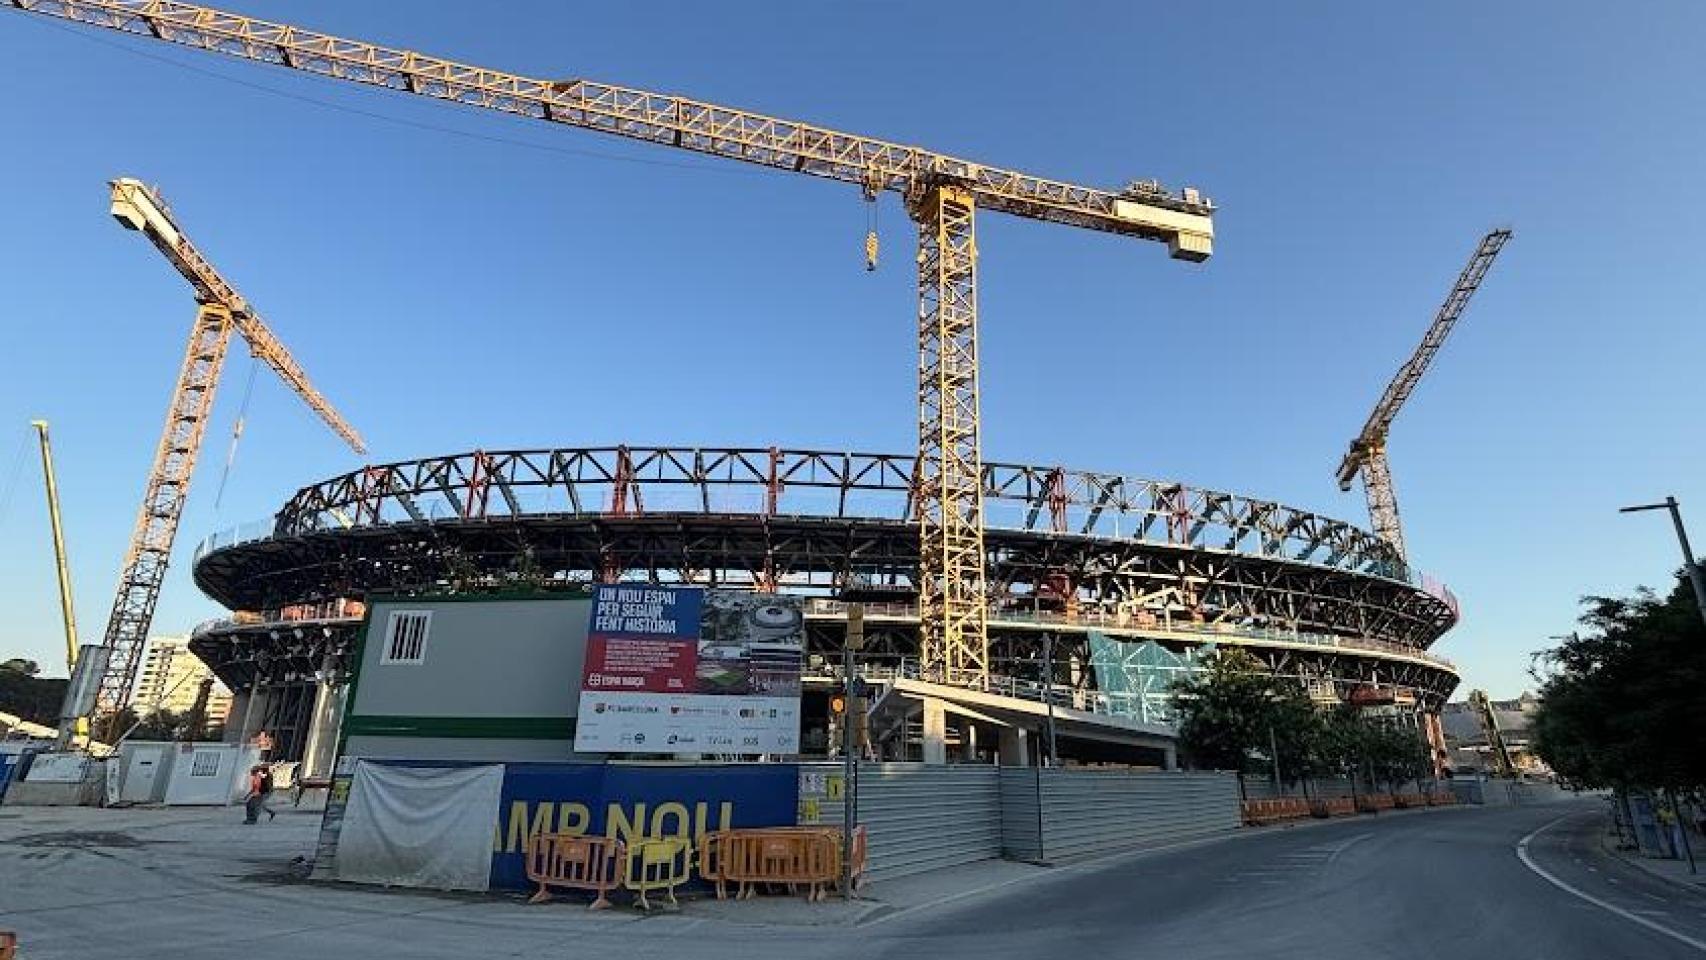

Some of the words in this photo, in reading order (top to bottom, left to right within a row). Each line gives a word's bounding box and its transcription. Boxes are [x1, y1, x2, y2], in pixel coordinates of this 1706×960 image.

[600, 587, 616, 601] UN
[618, 589, 642, 603] NOU
[644, 590, 676, 605] ESPAI
[598, 601, 620, 616] PER
[621, 603, 664, 620] SEGUIR
[594, 615, 623, 632] FENT
